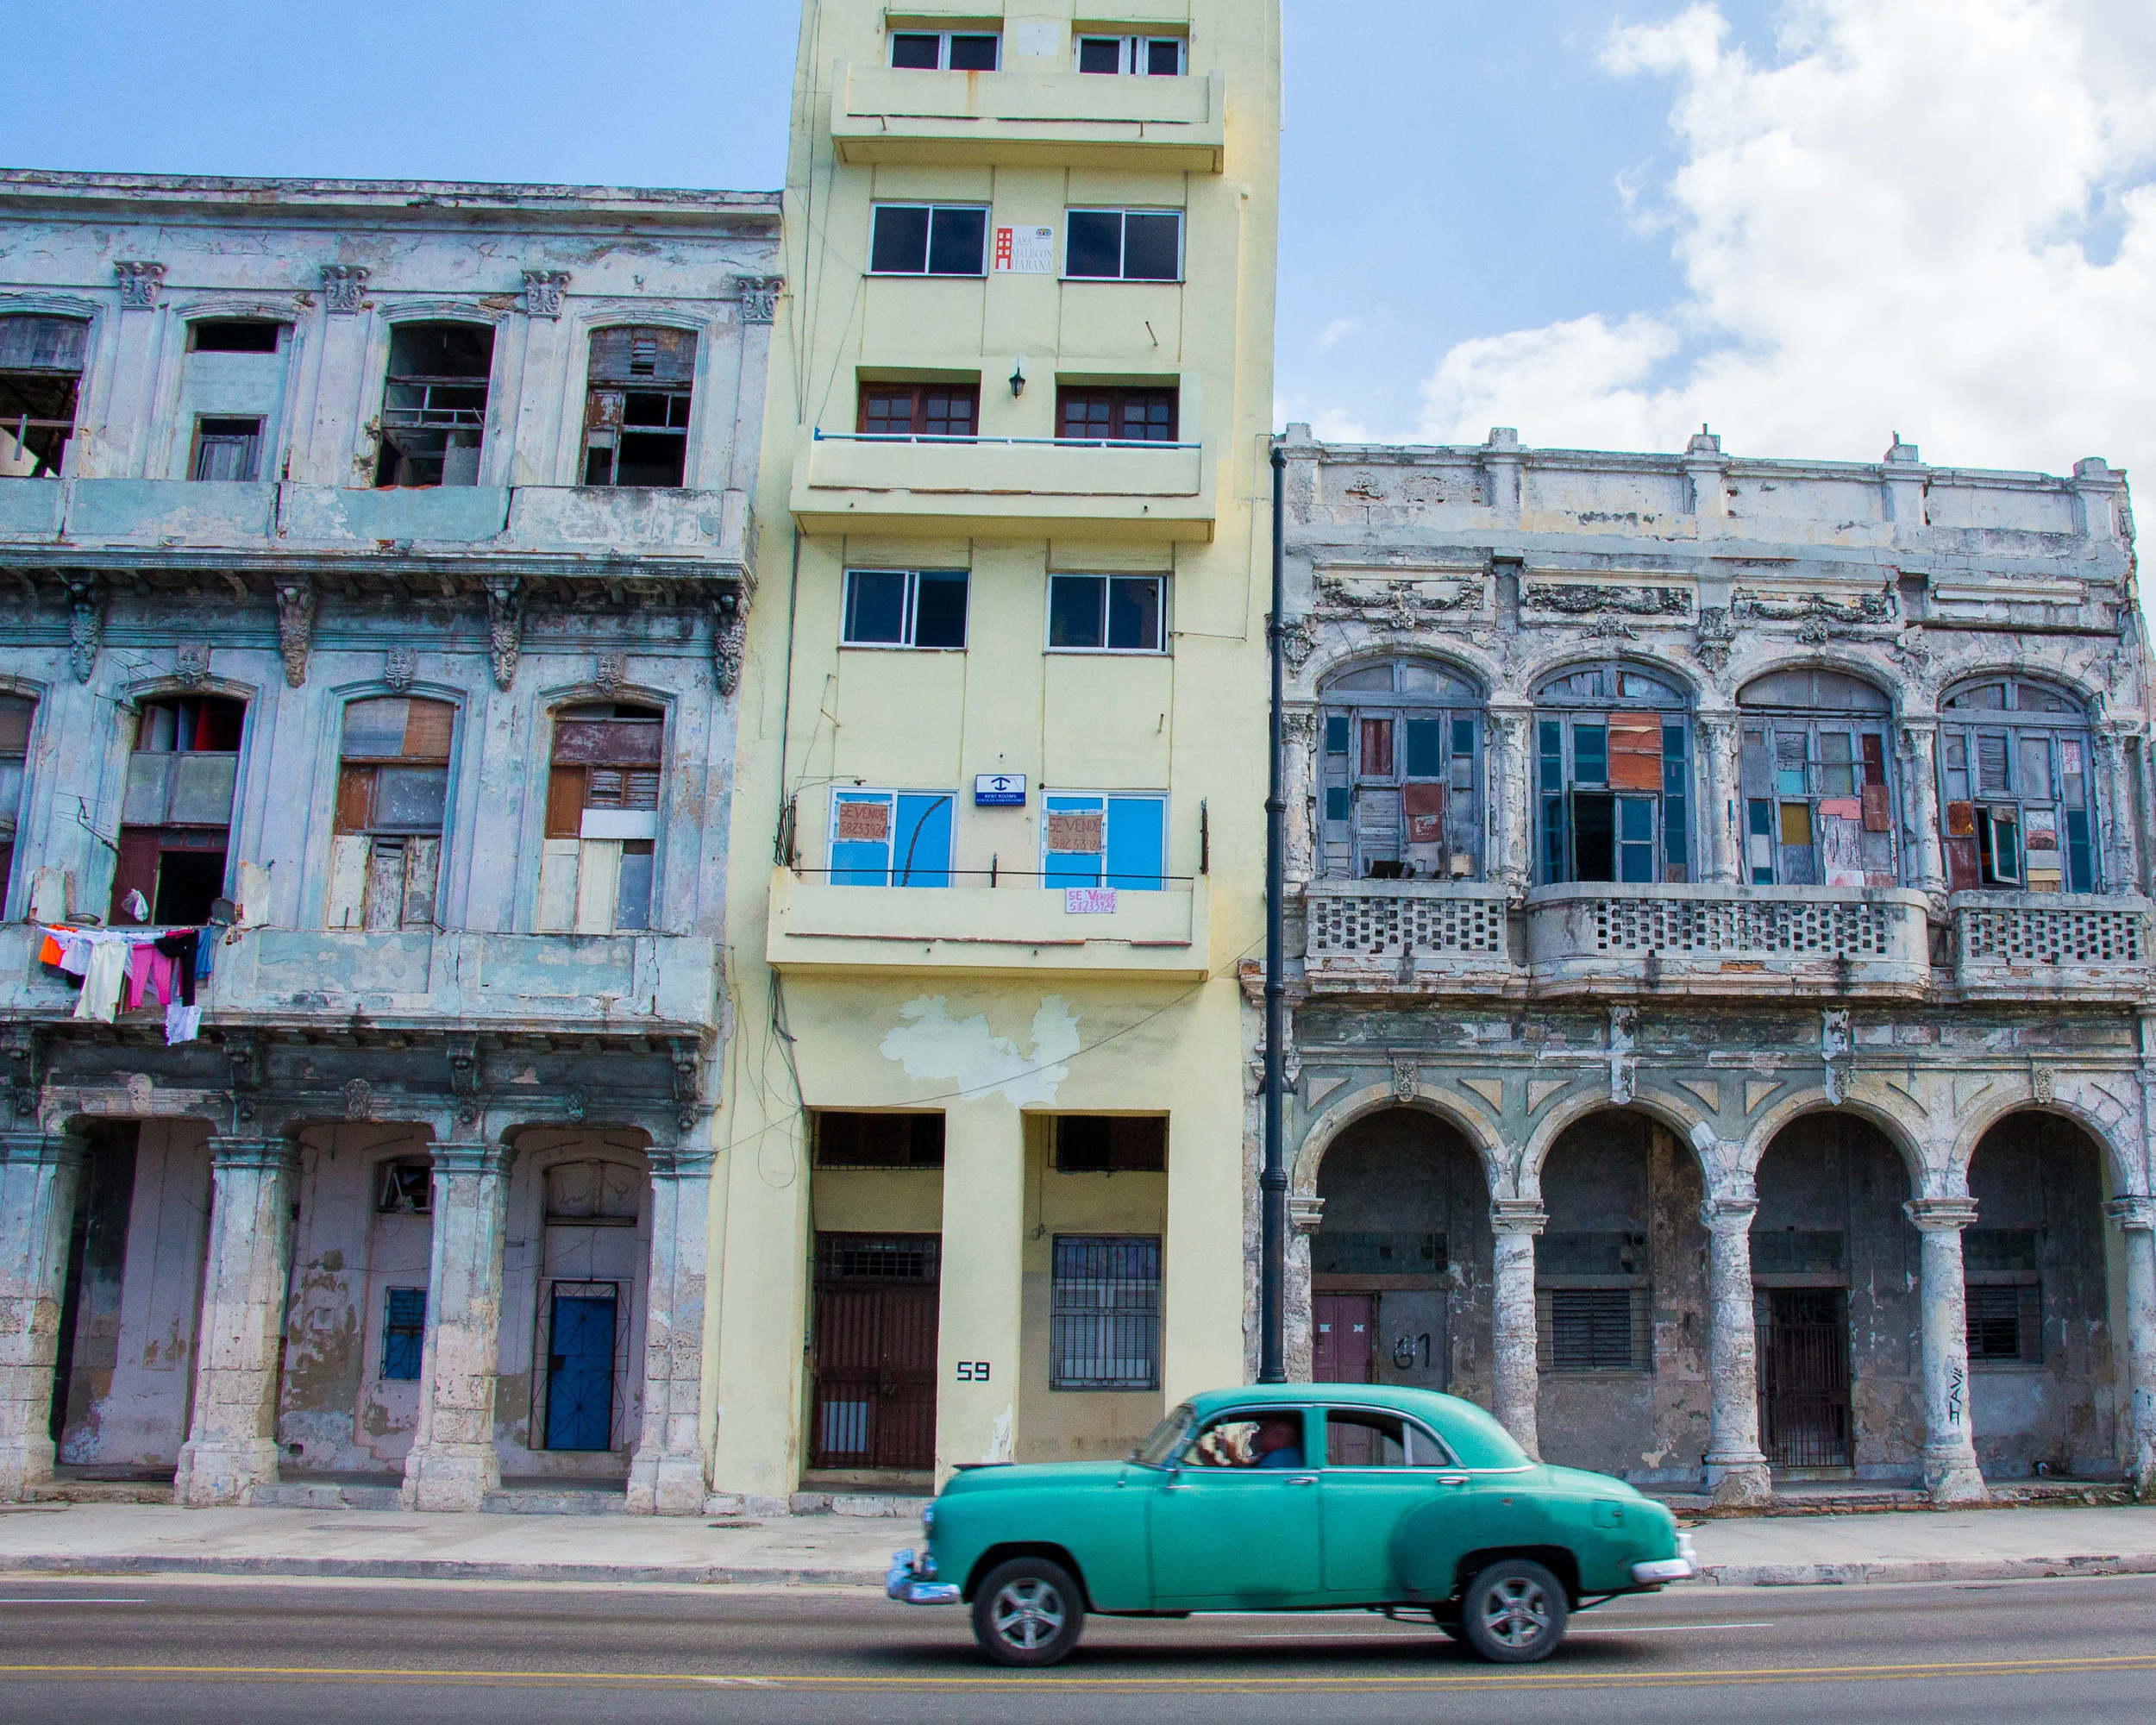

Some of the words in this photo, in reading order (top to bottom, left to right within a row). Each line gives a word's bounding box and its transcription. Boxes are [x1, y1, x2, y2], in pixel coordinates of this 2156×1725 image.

[1012, 236, 1032, 246] CASA
[1012, 259, 1051, 271] HABANA
[840, 805, 854, 818] SE
[855, 806, 887, 821] VENDE
[1049, 818, 1063, 832] SE
[1063, 818, 1101, 833] VENDE
[1069, 891, 1082, 900] SE
[1393, 1333, 1431, 1371] 61
[957, 1361, 990, 1382] 59
